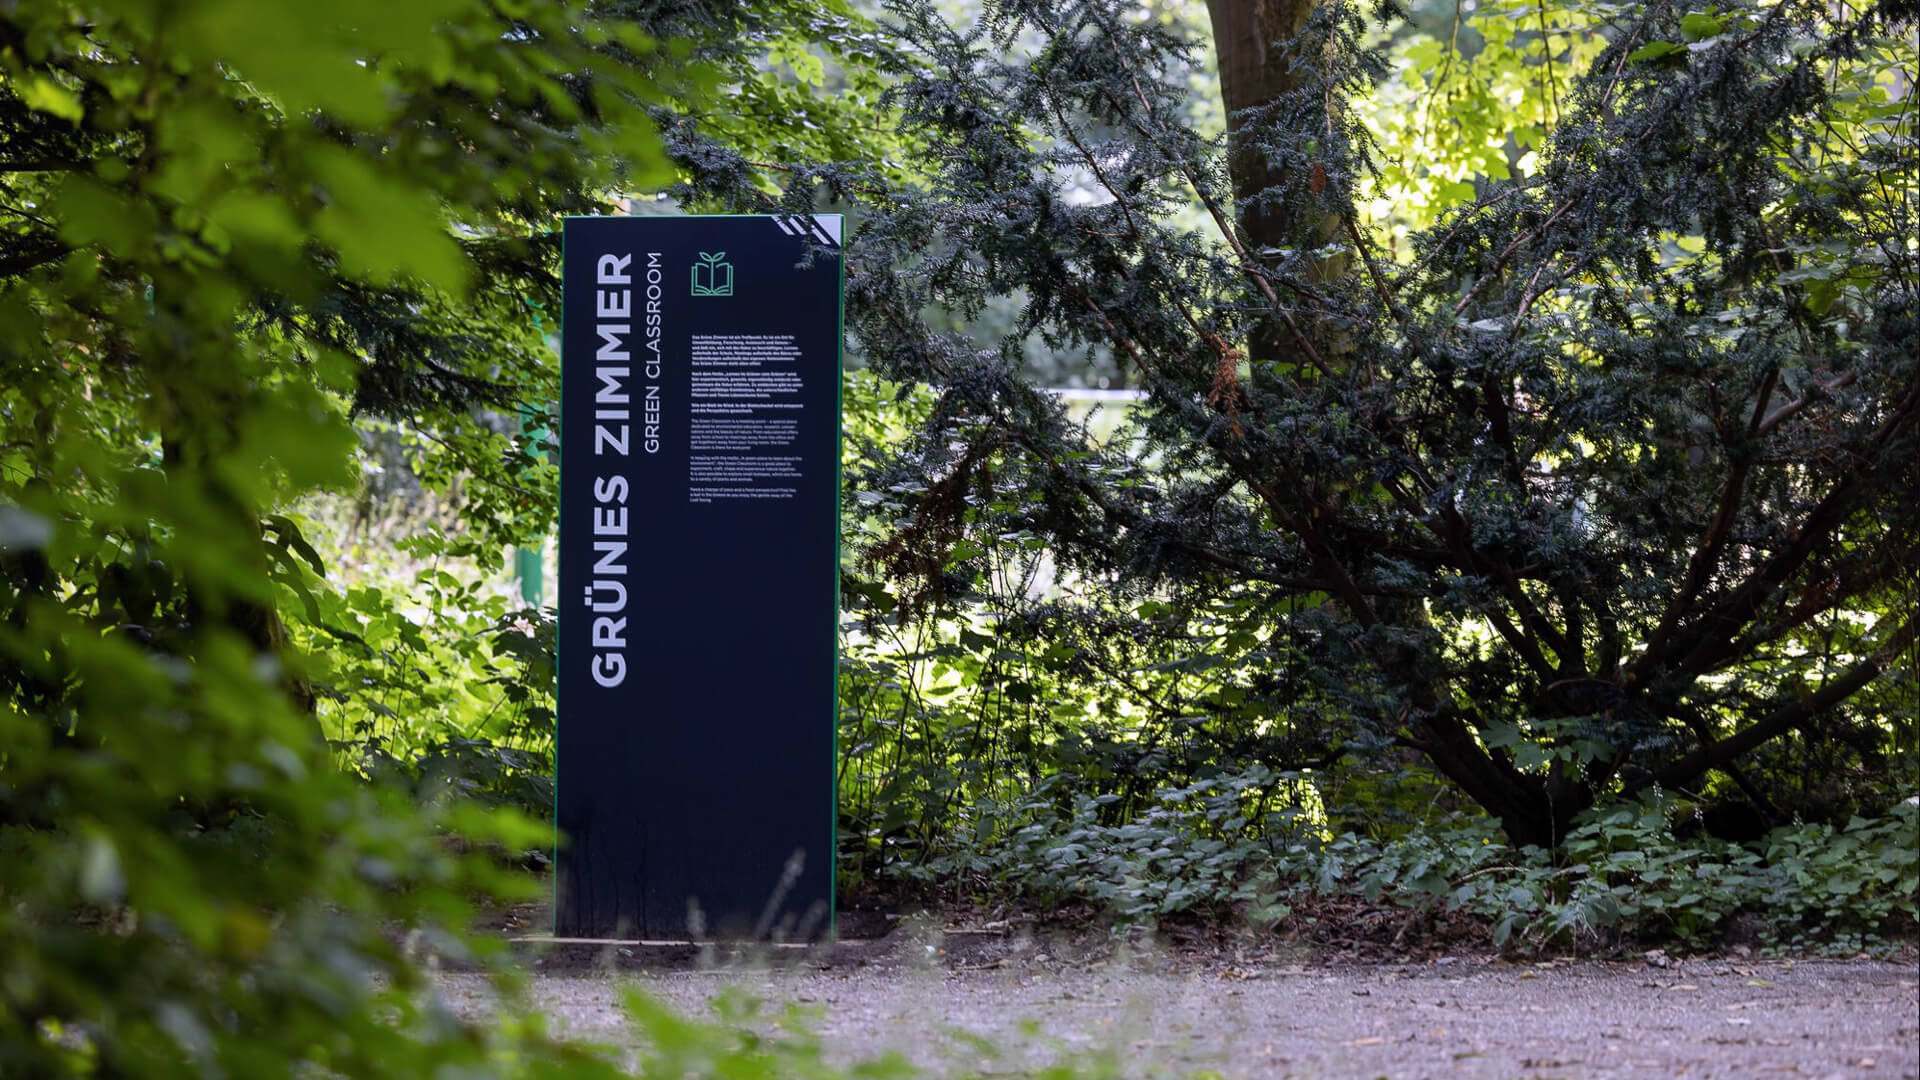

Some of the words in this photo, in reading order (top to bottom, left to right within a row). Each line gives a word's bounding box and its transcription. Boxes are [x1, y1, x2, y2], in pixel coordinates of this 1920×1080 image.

[595, 253, 631, 456] ZIMMER
[646, 253, 661, 378] CLASSROOM
[645, 386, 659, 453] GREEN
[584, 475, 629, 687] GRÜNES
